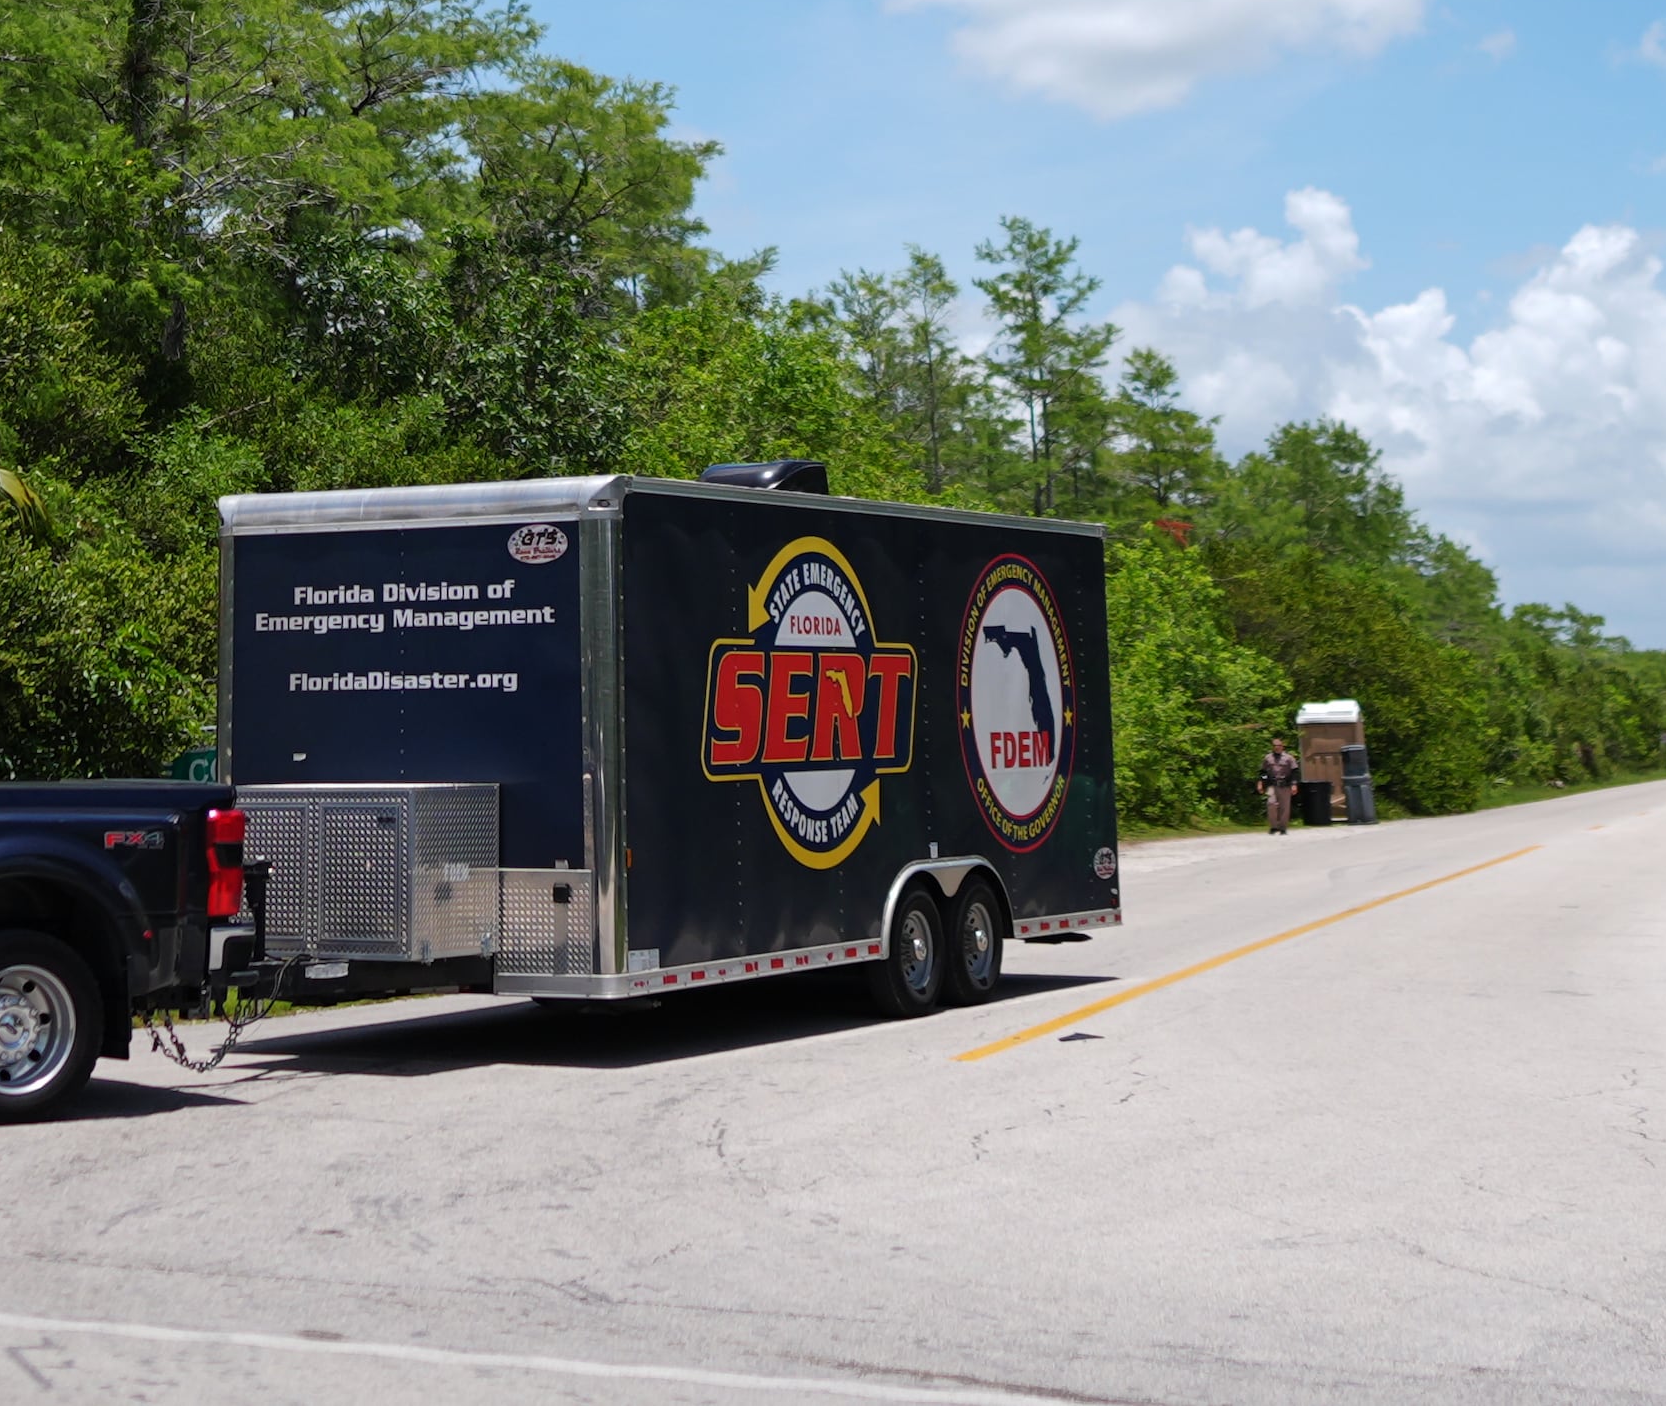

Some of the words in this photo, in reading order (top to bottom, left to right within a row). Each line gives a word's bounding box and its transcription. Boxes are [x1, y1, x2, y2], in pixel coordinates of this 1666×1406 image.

[293, 584, 375, 606] Florida
[382, 581, 479, 603] Division
[486, 578, 516, 600] of
[769, 567, 801, 625] STATE
[802, 561, 866, 637] EMERGENCY
[255, 611, 385, 635] Emergency
[392, 605, 556, 631] Management
[789, 614, 843, 637] FLORIDA
[960, 604, 980, 688] DIVISION
[976, 584, 988, 608] OF
[985, 563, 1034, 592] EMERGENCY
[1033, 577, 1071, 688] MANAGEMENT
[289, 671, 519, 693] FloridaDisaster.org
[710, 650, 912, 766] SERT
[989, 730, 1051, 770] FDEM
[771, 777, 829, 843] RESPONSE
[830, 792, 860, 839] TEAM
[976, 777, 1002, 828] OFFICE
[1001, 819, 1014, 838] OF
[1013, 824, 1029, 841] THE
[1028, 773, 1066, 838] GOVERNOR
[104, 830, 165, 850] FX4
